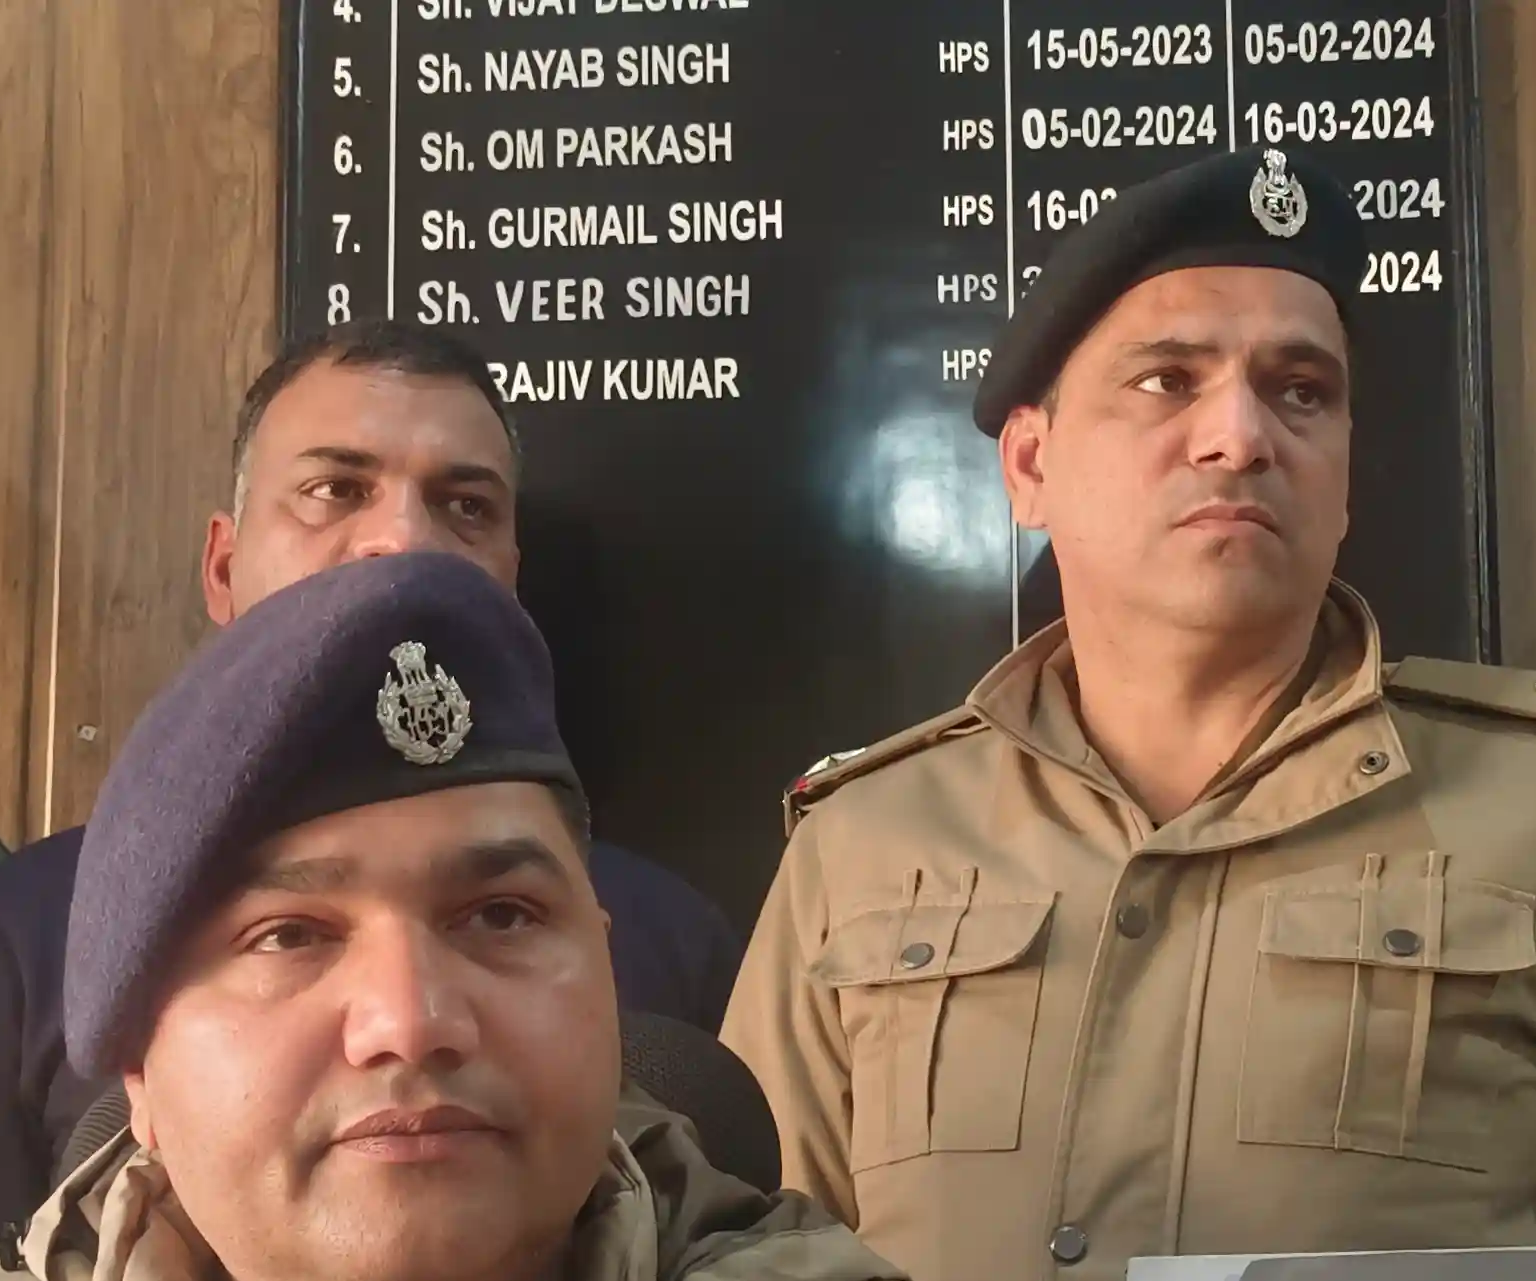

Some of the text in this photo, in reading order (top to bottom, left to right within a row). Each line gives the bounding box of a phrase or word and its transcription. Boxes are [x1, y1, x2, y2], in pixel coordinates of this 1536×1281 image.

[333, 17, 1436, 97] 5. Sh. NAYAB SINGH HPS 15-05-2023 05-02-2024
[333, 96, 1435, 175] 6. Sh. OM PARKASH HPS 05-02-2024 16-03-2024
[331, 214, 361, 253] 7.
[421, 209, 476, 251] Sh.
[487, 204, 658, 249] GURMAIL
[668, 199, 784, 244] SINGH
[943, 194, 994, 227] HPS
[1353, 178, 1446, 220] 2024
[327, 283, 351, 326] 8
[417, 280, 480, 325] Sh.
[495, 278, 606, 323] VEER
[624, 274, 751, 319] SINGH
[937, 273, 998, 304] HPS
[1359, 249, 1443, 293] 2024
[486, 359, 593, 402] RAJIV
[603, 357, 740, 400] KUMAR
